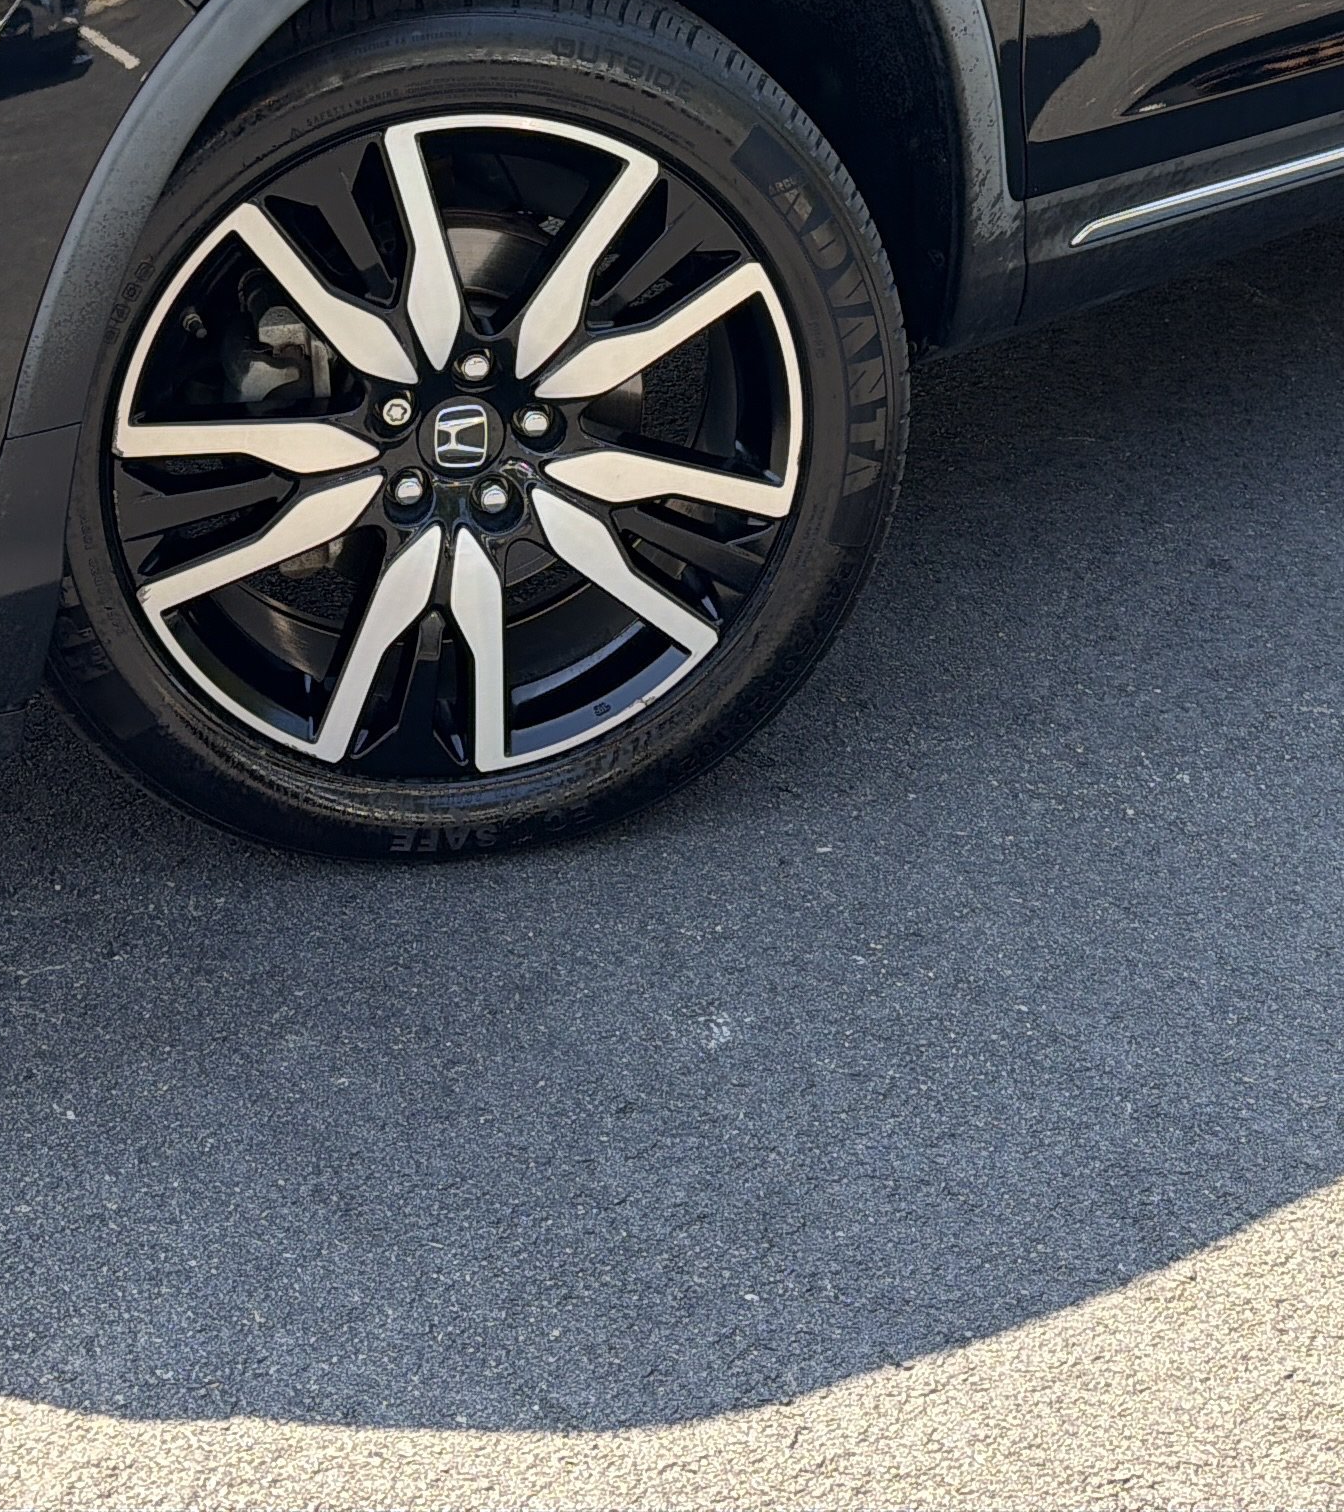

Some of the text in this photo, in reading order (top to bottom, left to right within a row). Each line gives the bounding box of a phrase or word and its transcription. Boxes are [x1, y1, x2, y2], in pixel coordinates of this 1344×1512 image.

[552, 36, 696, 103] OUTSIDE
[769, 182, 887, 498] ADVANTA
[390, 824, 498, 852] SAFE
